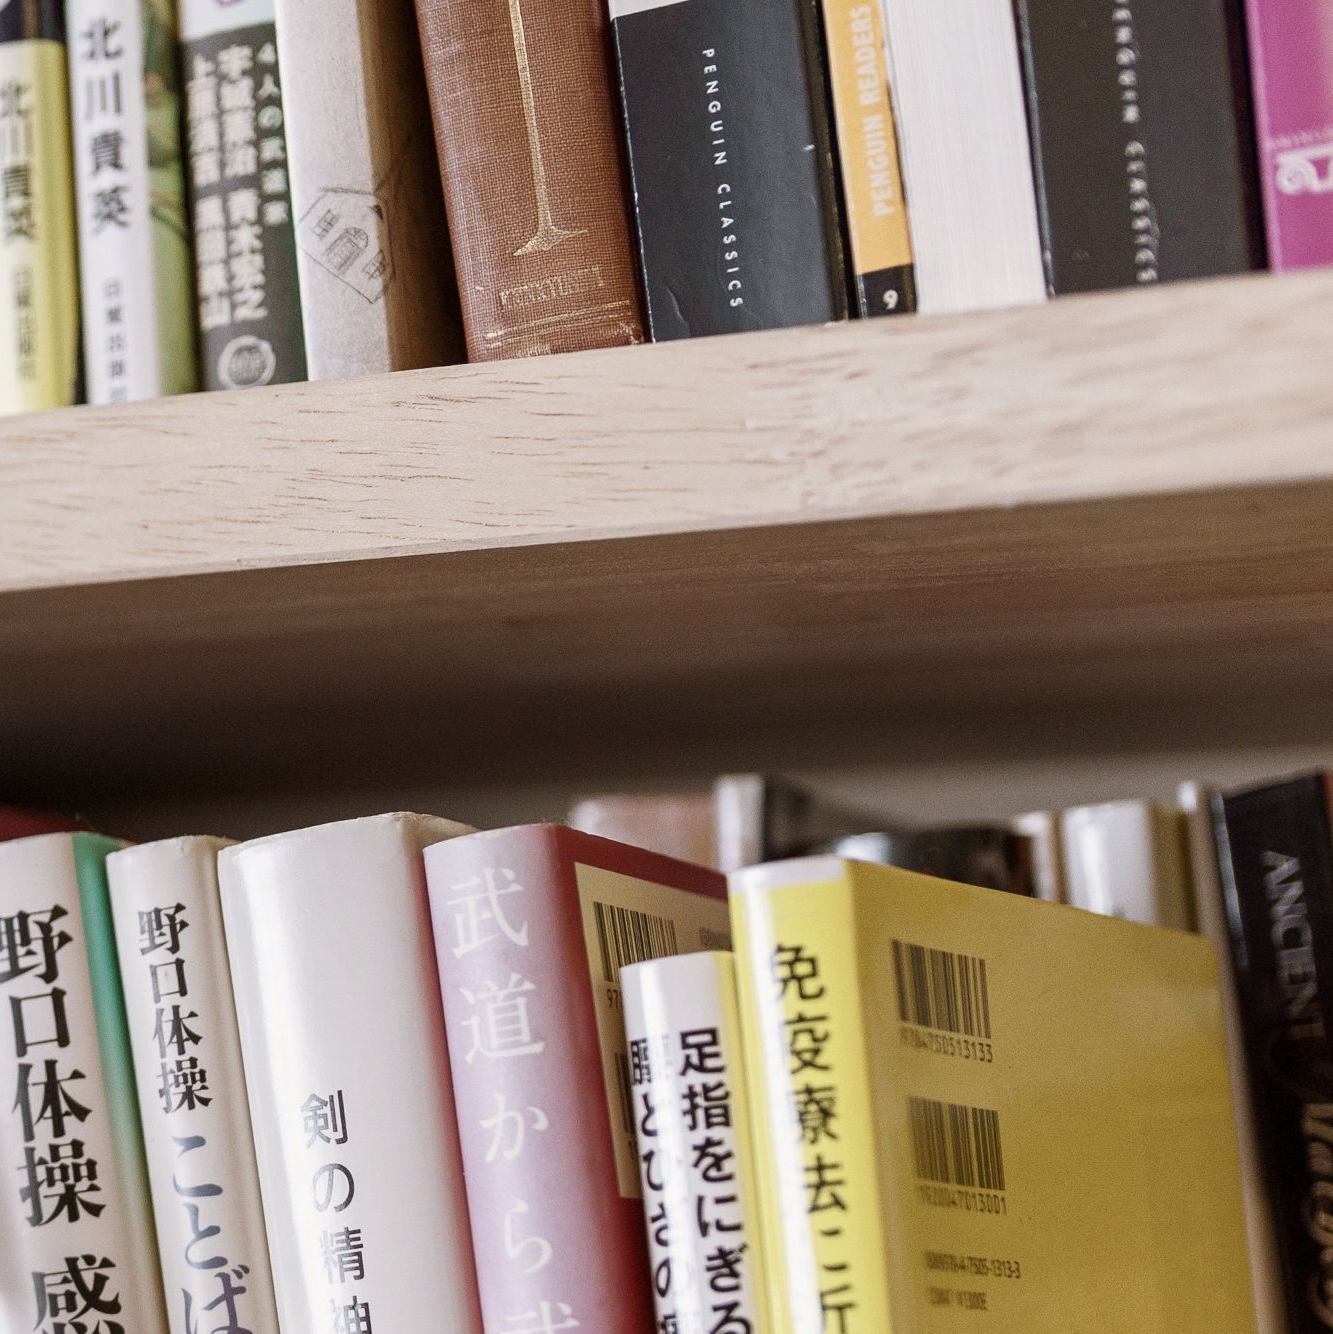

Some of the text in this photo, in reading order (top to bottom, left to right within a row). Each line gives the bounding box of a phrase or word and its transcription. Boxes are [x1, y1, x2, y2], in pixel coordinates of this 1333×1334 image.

[82, 17, 130, 236] 北川貴英
[702, 48, 744, 308] PENGUIN CLASSICS
[850, 5, 895, 217] PENGUIN READERS
[882, 288, 899, 311] 9
[137, 902, 214, 1116] 野口体操
[1263, 850, 1325, 1042] ANCIENT
